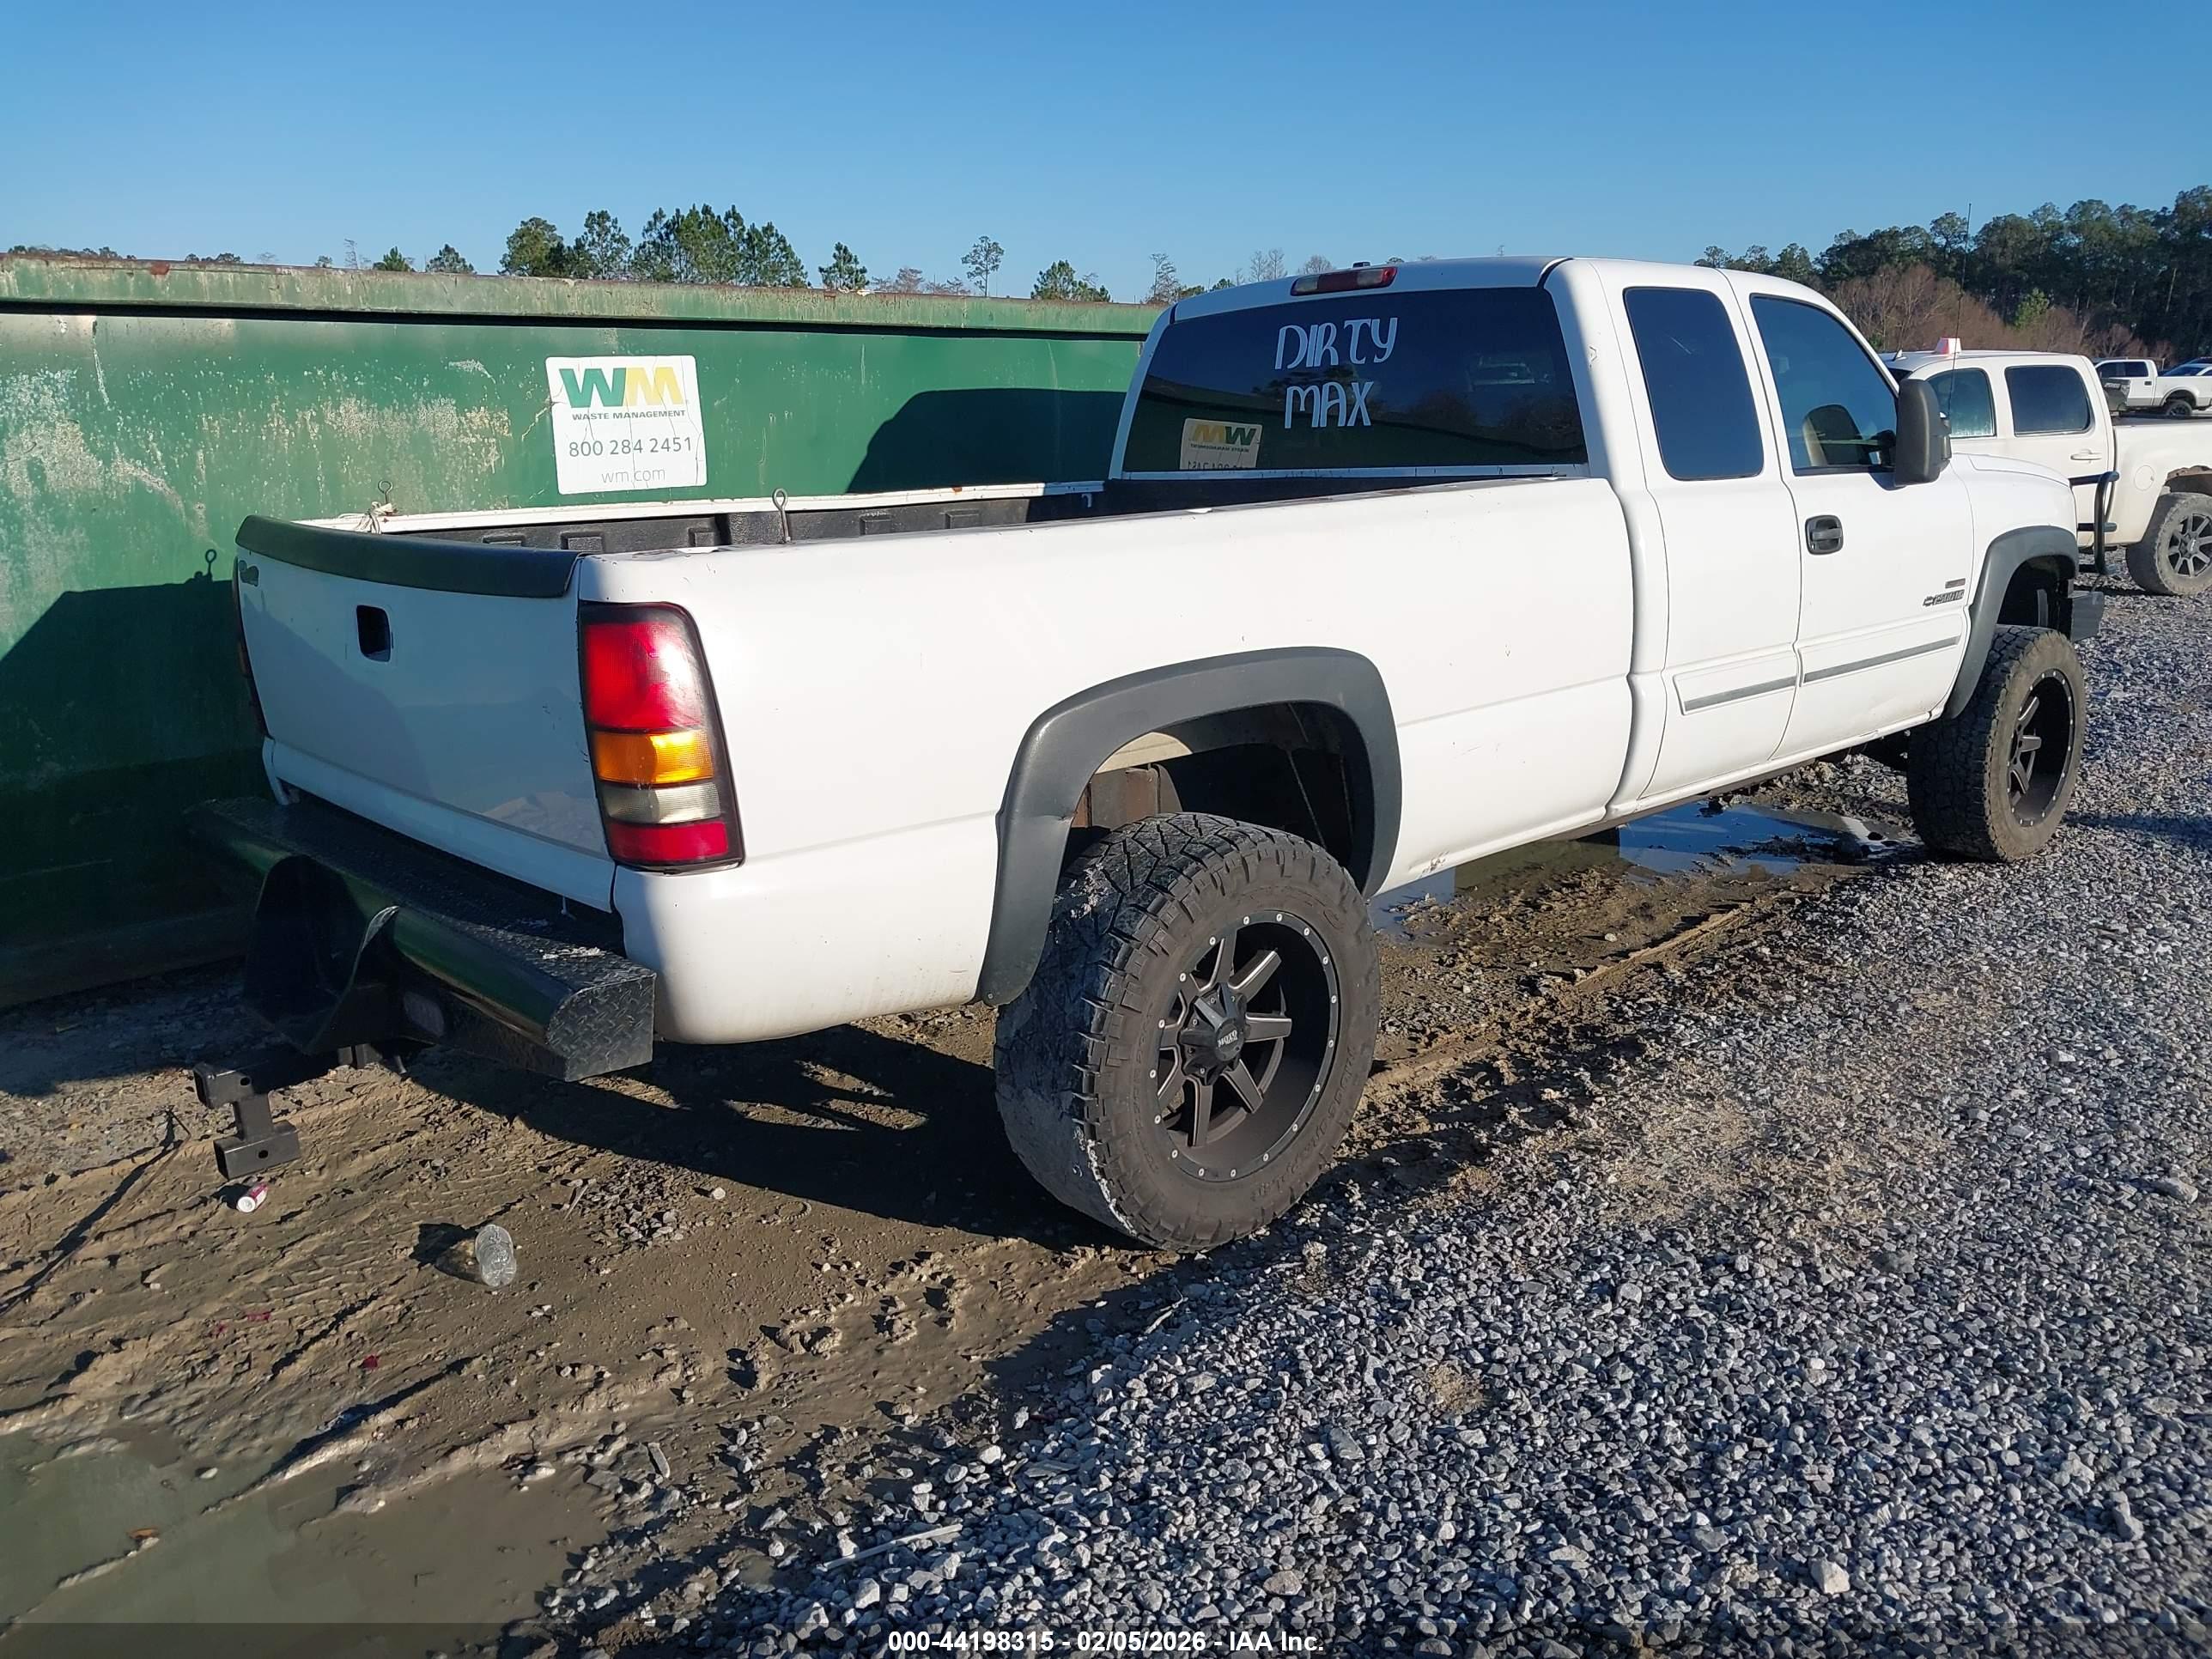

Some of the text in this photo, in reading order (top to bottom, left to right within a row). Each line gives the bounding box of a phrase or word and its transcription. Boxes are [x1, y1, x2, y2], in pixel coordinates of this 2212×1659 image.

[1275, 317, 1398, 370] DIRTY
[558, 367, 684, 408] WM
[572, 410, 686, 421] WASTE MANAGEMENT
[1284, 380, 1374, 429] MAX
[568, 437, 690, 457] 800 284 2451
[601, 469, 665, 483] wm.com
